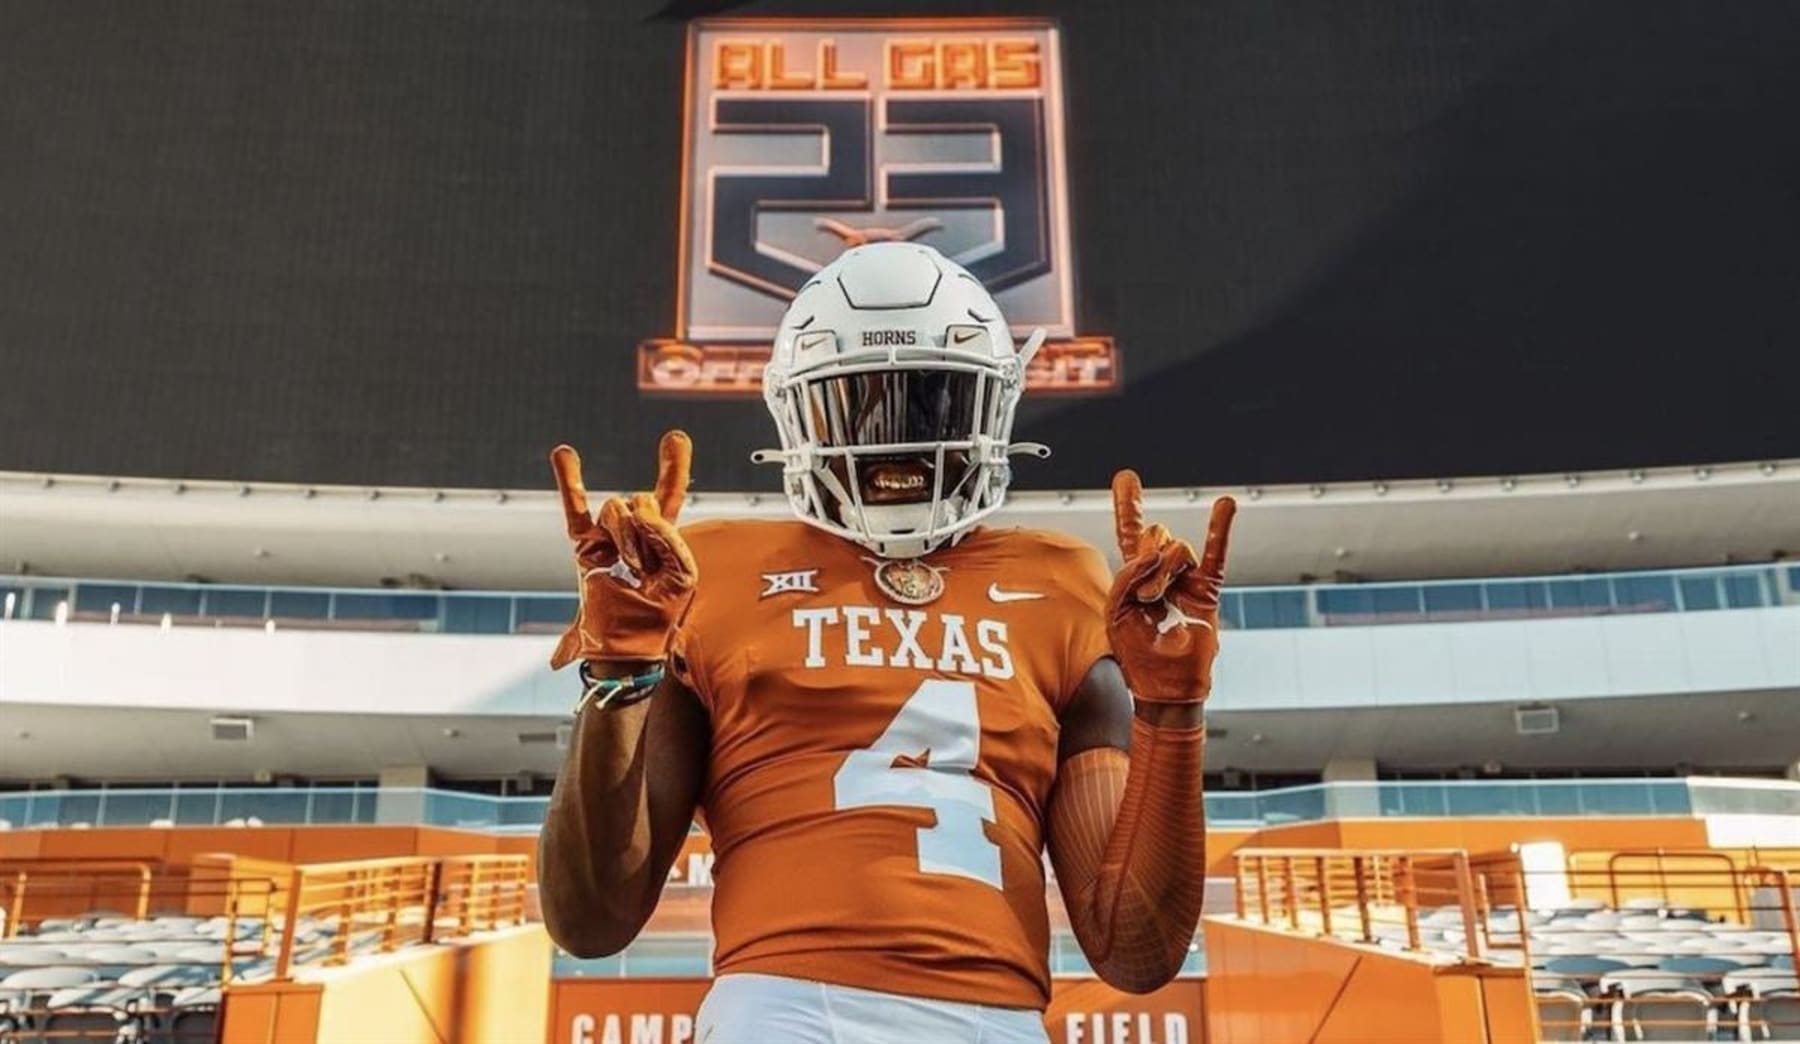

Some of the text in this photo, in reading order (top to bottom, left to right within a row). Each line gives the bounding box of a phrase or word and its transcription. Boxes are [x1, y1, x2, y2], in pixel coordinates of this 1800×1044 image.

[713, 38, 1042, 90] ALL GAS
[707, 91, 1052, 305] 23
[861, 330, 917, 347] HORNS
[792, 605, 1015, 681] TEXAS
[832, 677, 1004, 891] 4
[1065, 1011, 1189, 1044] FIELD
